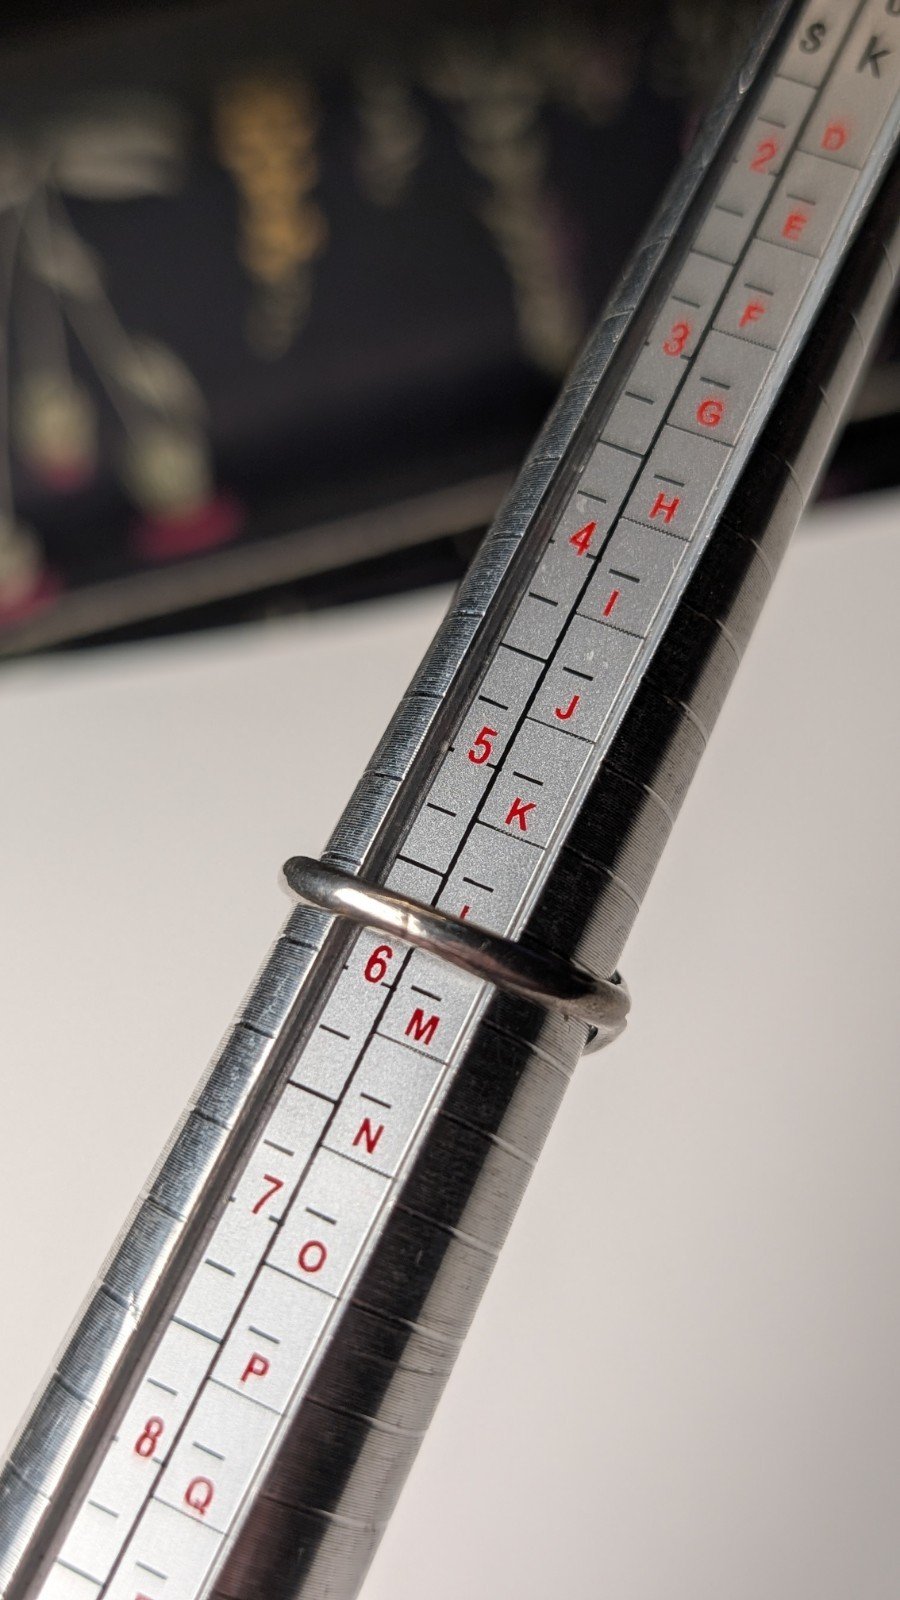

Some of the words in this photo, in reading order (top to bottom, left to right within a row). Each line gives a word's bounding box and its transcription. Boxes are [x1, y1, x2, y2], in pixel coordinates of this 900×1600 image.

[821, 122, 849, 152] D
[749, 139, 778, 173] 2
[782, 209, 808, 240] E
[738, 300, 766, 328] F
[662, 320, 692, 357] 3
[696, 398, 725, 428] G
[649, 491, 681, 524] H
[568, 520, 597, 557] 4
[602, 589, 621, 618] I
[554, 694, 581, 721] J
[467, 725, 499, 765] 5
[504, 796, 537, 832] K
[363, 944, 394, 984] 6
[404, 1007, 440, 1046] M
[352, 1117, 385, 1155] N
[252, 1173, 284, 1215] 7
[240, 1352, 270, 1384] P
[134, 1415, 165, 1459] 8
[184, 1476, 215, 1516] Q
